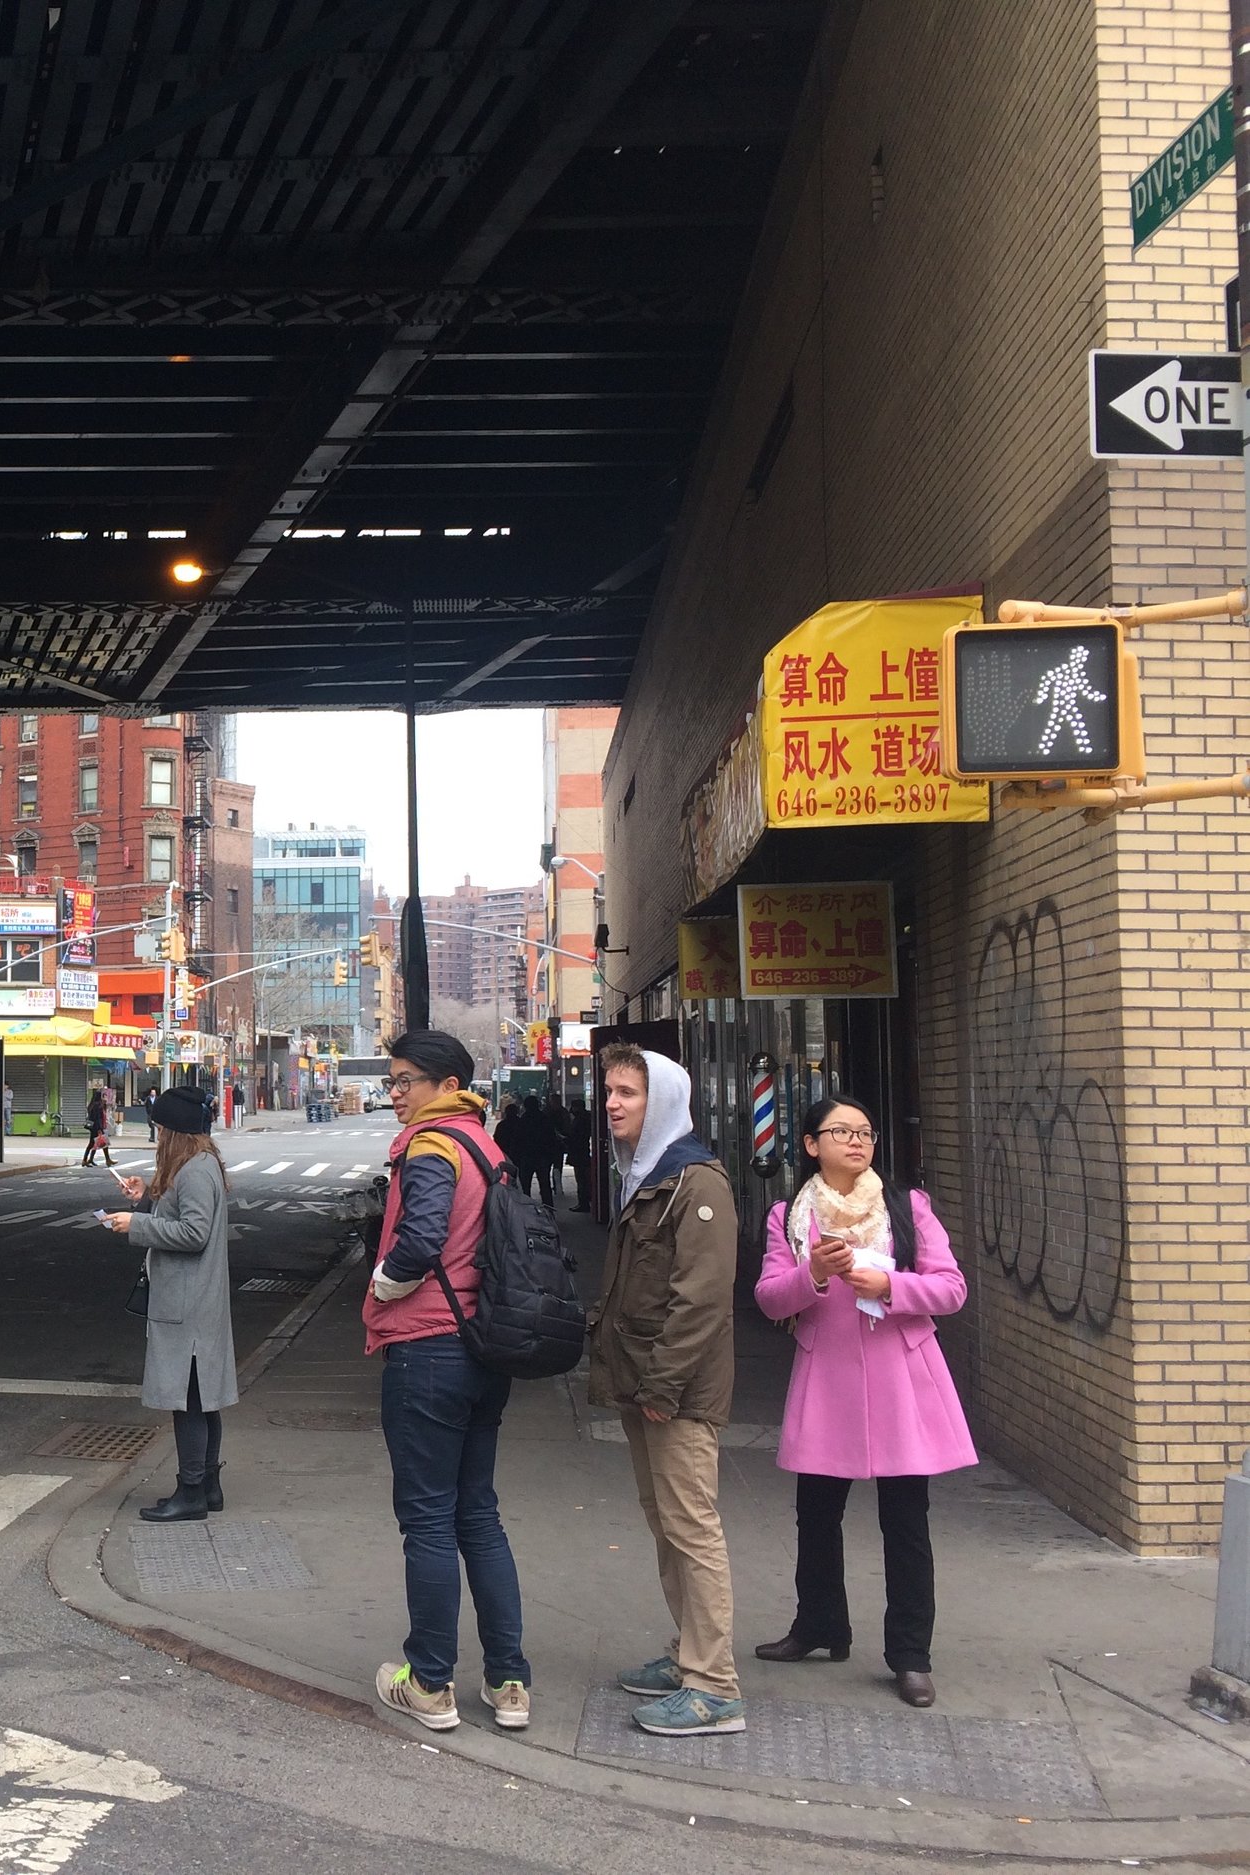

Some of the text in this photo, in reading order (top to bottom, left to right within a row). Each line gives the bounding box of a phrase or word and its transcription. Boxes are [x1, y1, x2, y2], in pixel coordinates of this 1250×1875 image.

[1134, 105, 1221, 219] DIVISION
[1160, 154, 1217, 219] 地威臣街
[1144, 386, 1231, 424] ONE
[779, 652, 849, 708] 算命
[782, 724, 941, 782] 风水 道场
[777, 784, 950, 818] 646-236-3897
[684, 969, 738, 992] 職業
[754, 970, 865, 984] 646-236-3897
